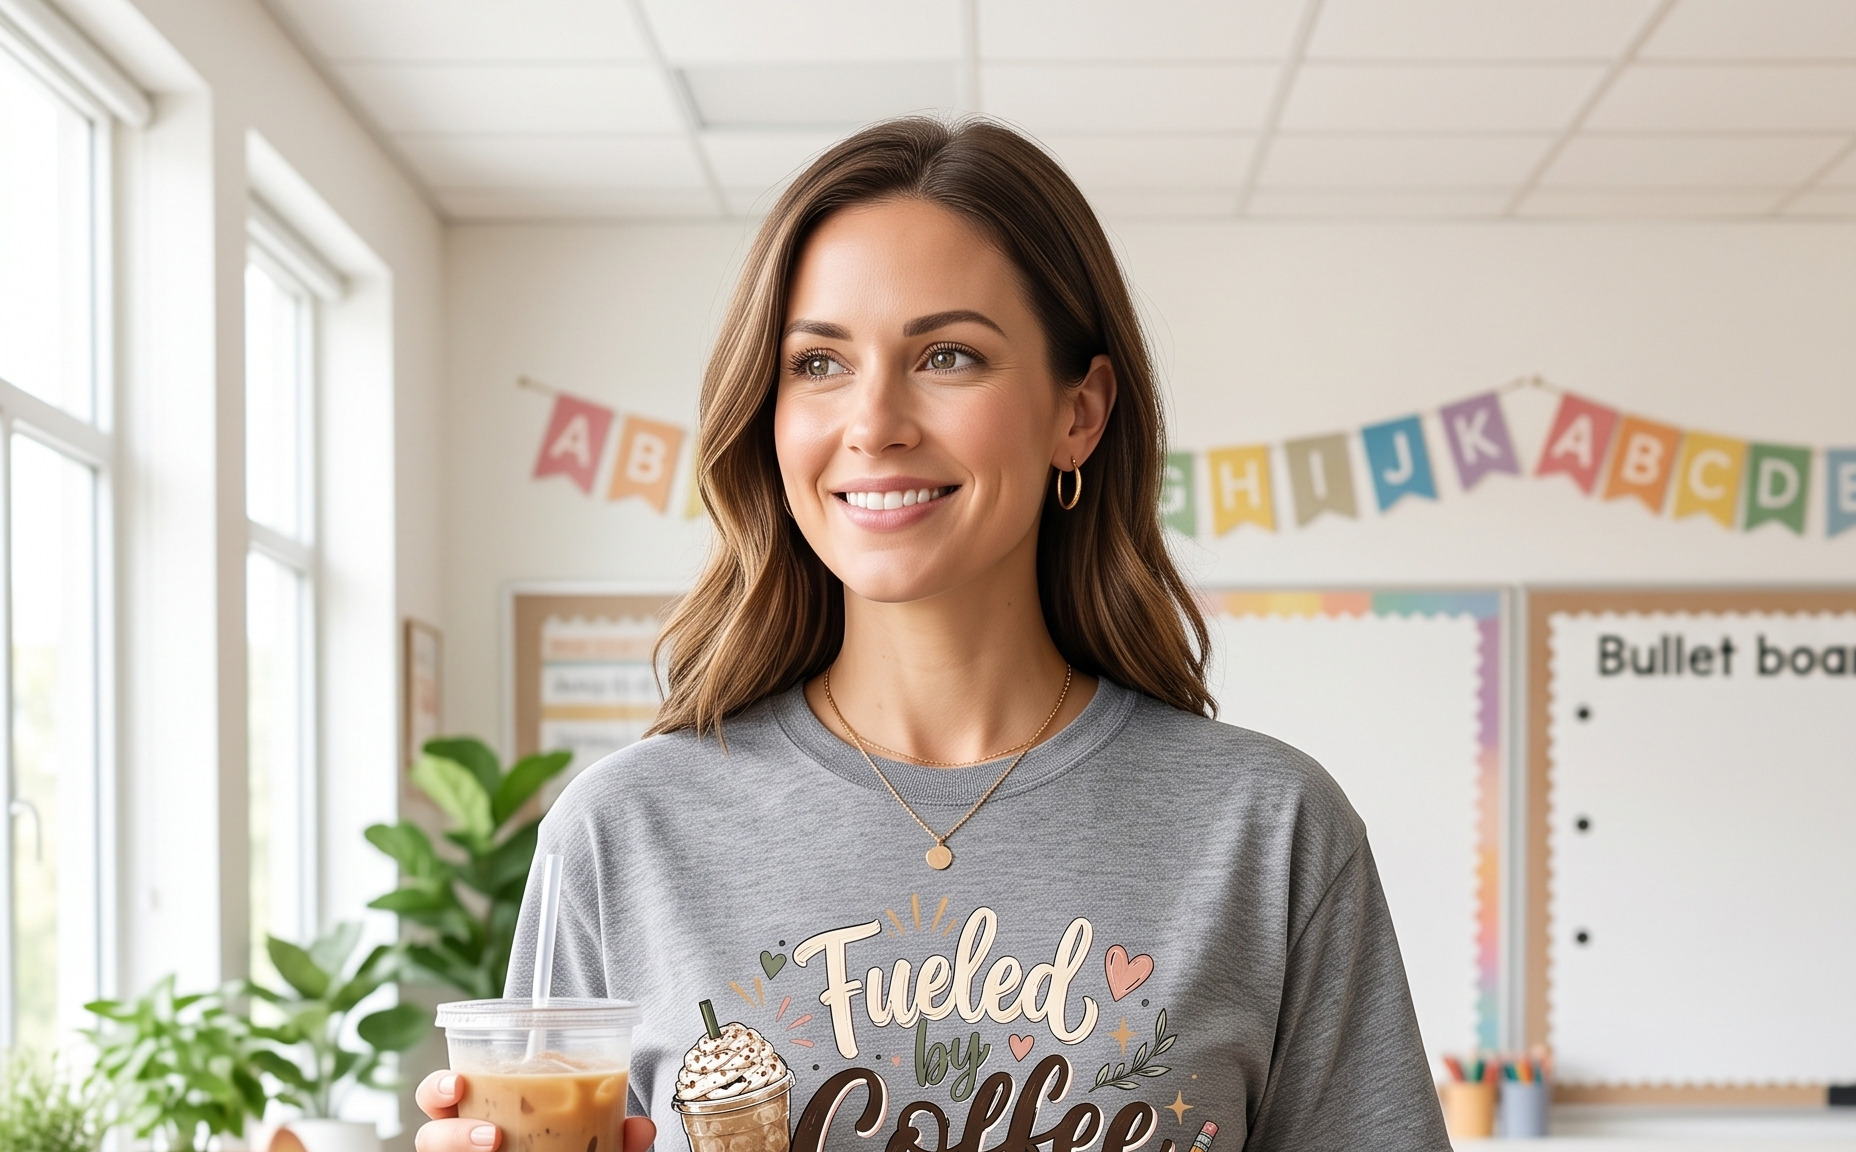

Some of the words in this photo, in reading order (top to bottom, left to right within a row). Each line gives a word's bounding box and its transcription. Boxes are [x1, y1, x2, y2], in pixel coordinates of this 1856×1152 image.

[549, 413, 591, 469] A
[625, 430, 668, 484] B
[1219, 460, 1261, 512] H
[1308, 449, 1328, 500] I
[1383, 430, 1414, 486] J
[1453, 407, 1500, 466] K
[1551, 413, 1593, 470] A
[1620, 431, 1664, 486] B
[1688, 449, 1732, 501] C
[1757, 457, 1799, 510] D
[1598, 634, 1736, 677] Bullet
[1757, 634, 1856, 677] boa
[793, 906, 1099, 1060] Fueled
[914, 1018, 993, 1103] by
